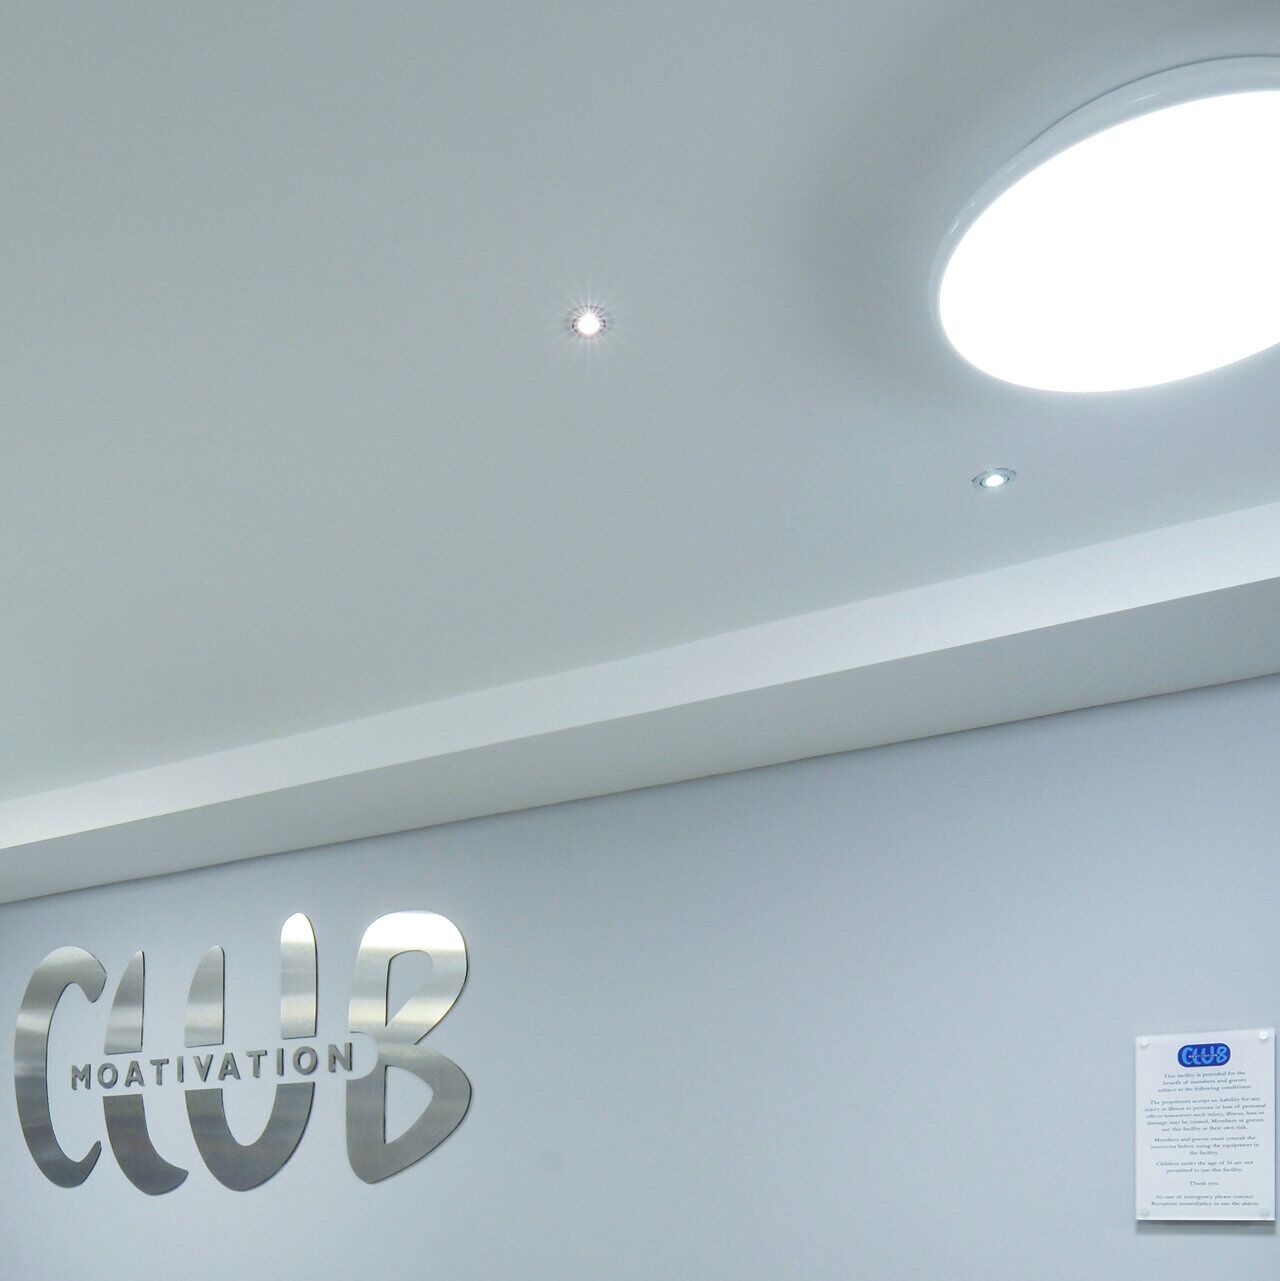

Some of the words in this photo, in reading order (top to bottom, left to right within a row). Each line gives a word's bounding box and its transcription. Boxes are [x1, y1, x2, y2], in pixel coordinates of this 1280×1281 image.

[13, 910, 473, 1197] CLUB
[70, 1040, 354, 1091] MOATIVATION
[1181, 1045, 1228, 1066] CLUB
